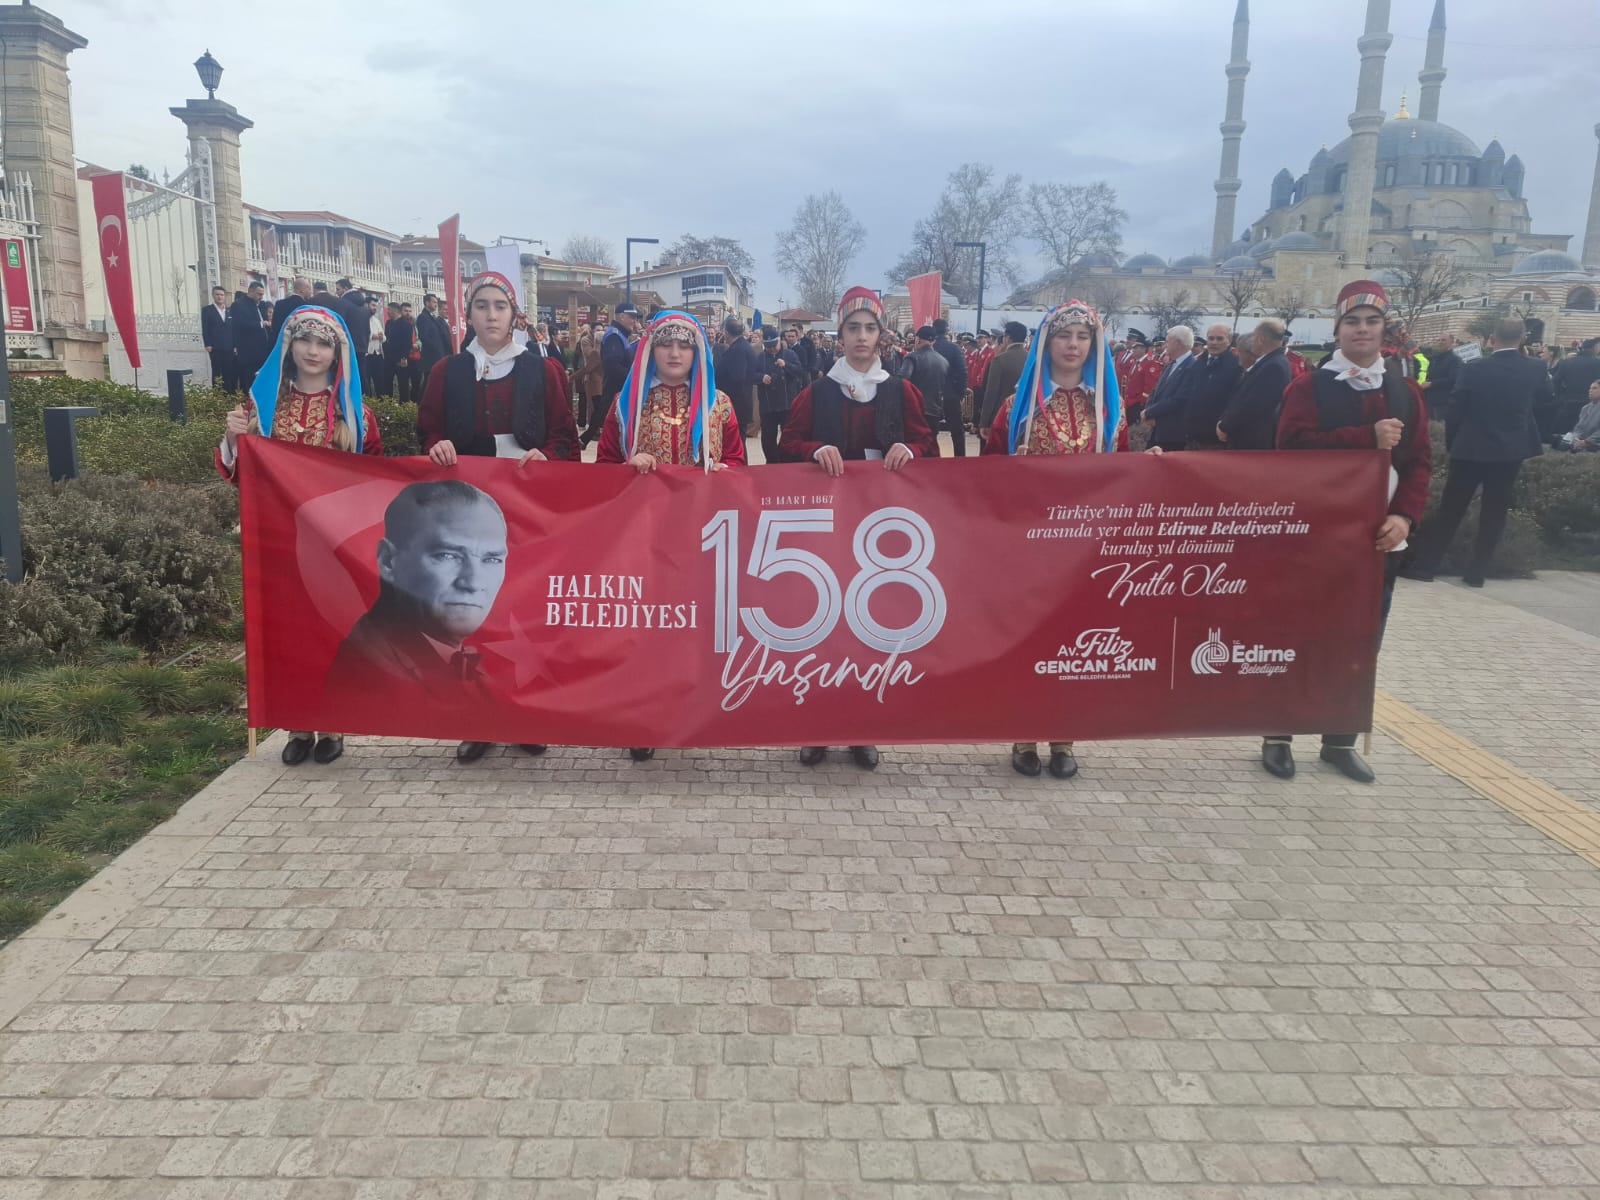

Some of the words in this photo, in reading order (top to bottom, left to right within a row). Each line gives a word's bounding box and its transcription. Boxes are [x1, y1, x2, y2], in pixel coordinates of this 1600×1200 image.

[761, 496, 771, 505] 13
[776, 495, 806, 505] MART
[811, 495, 834, 504] 1867
[1137, 502, 1154, 518] ilk
[1158, 502, 1213, 517] kurulan
[1217, 501, 1296, 519] belediyeleri
[1027, 523, 1092, 539] arasında
[1095, 525, 1121, 540] yer
[1123, 522, 1154, 537] alan
[1157, 521, 1207, 536] Edirne
[1210, 520, 1310, 538] Belediyesi'nin
[1100, 540, 1153, 557] kuruluş
[1155, 540, 1174, 557] yıl
[1177, 539, 1235, 555] dönümü
[547, 574, 644, 599] HALKIN
[702, 506, 947, 653] 158
[1090, 560, 1177, 607] Kutlu
[1181, 562, 1247, 597] Olsun
[545, 600, 698, 629] BELEDİYESİ
[1057, 644, 1079, 657] Av.
[1075, 626, 1135, 664] Filiz
[1232, 644, 1296, 663] Edirne
[721, 636, 925, 712] Yaşında
[1034, 659, 1108, 674] GENCAN
[1114, 658, 1156, 672] AKIN
[1238, 662, 1288, 677] Belediyesi
